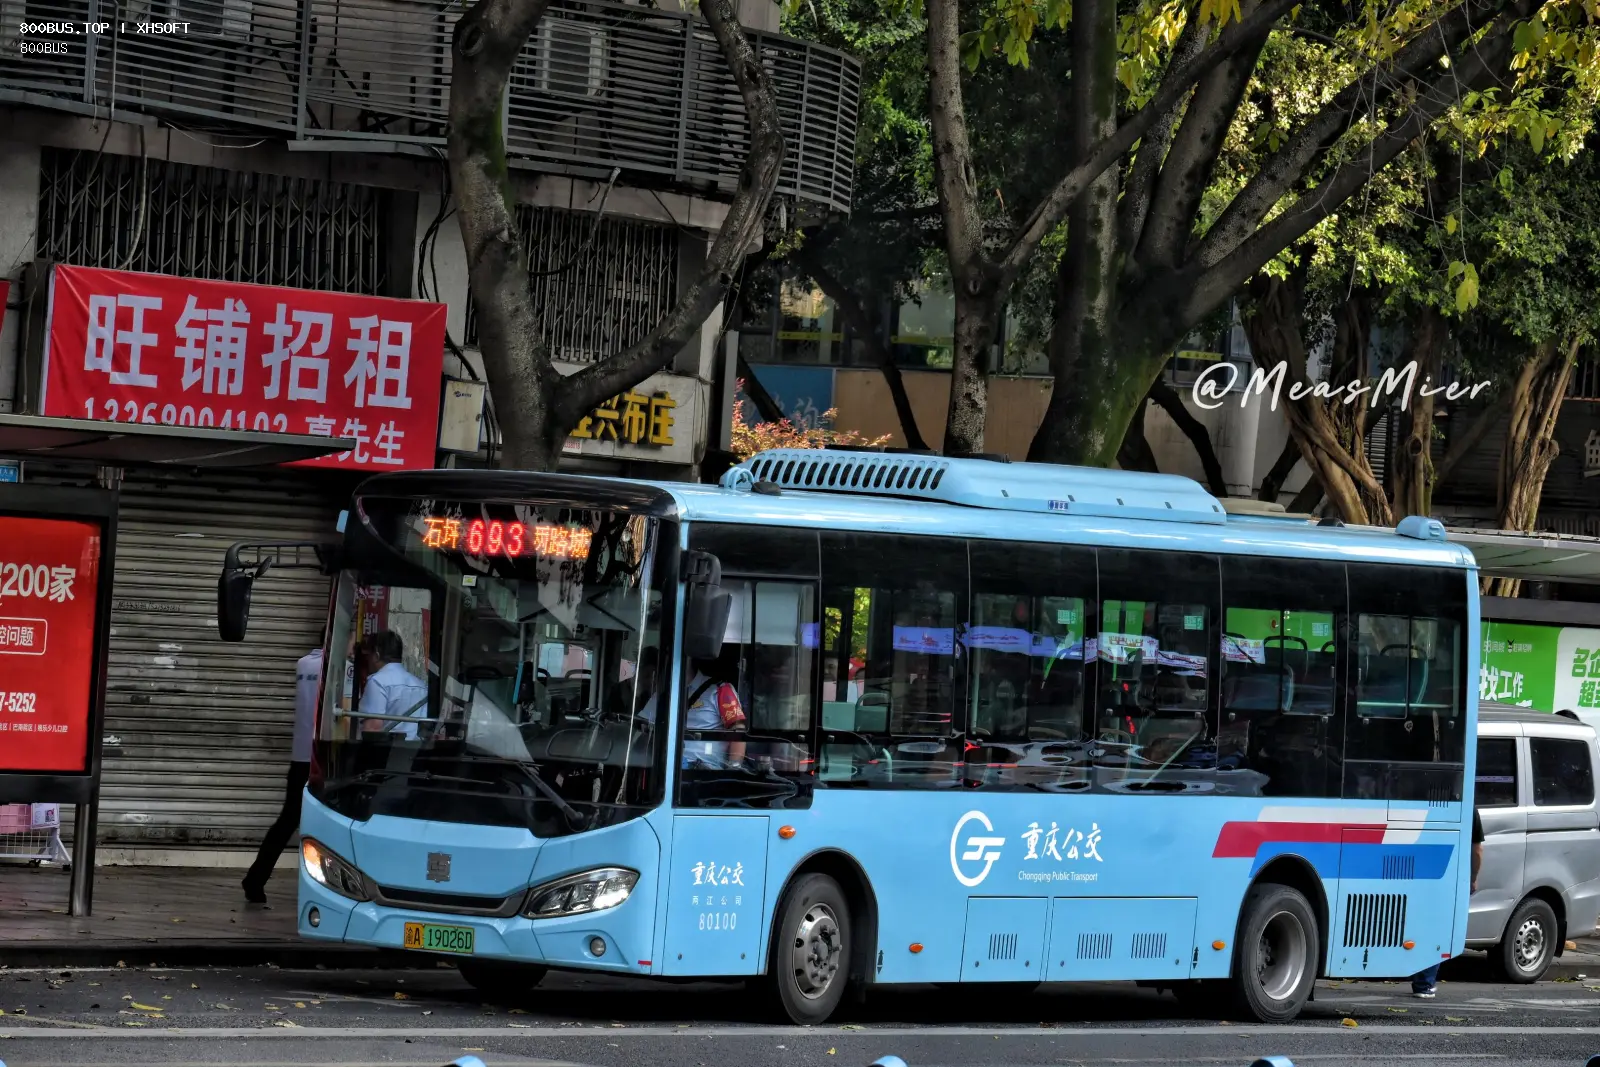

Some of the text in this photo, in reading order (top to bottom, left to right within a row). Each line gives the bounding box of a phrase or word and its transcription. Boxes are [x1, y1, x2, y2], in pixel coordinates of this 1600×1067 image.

[84, 293, 412, 410] 旺铺招租
[468, 519, 524, 557] 693
[0, 562, 76, 603] 200家
[1479, 663, 1524, 701] 找工作
[1020, 821, 1104, 862] 重庆公交
[691, 861, 745, 887] 重庆公交
[1018, 870, 1098, 883] Chongqing Public Transport
[692, 895, 742, 906] 两江公司
[699, 912, 737, 930] 80100
